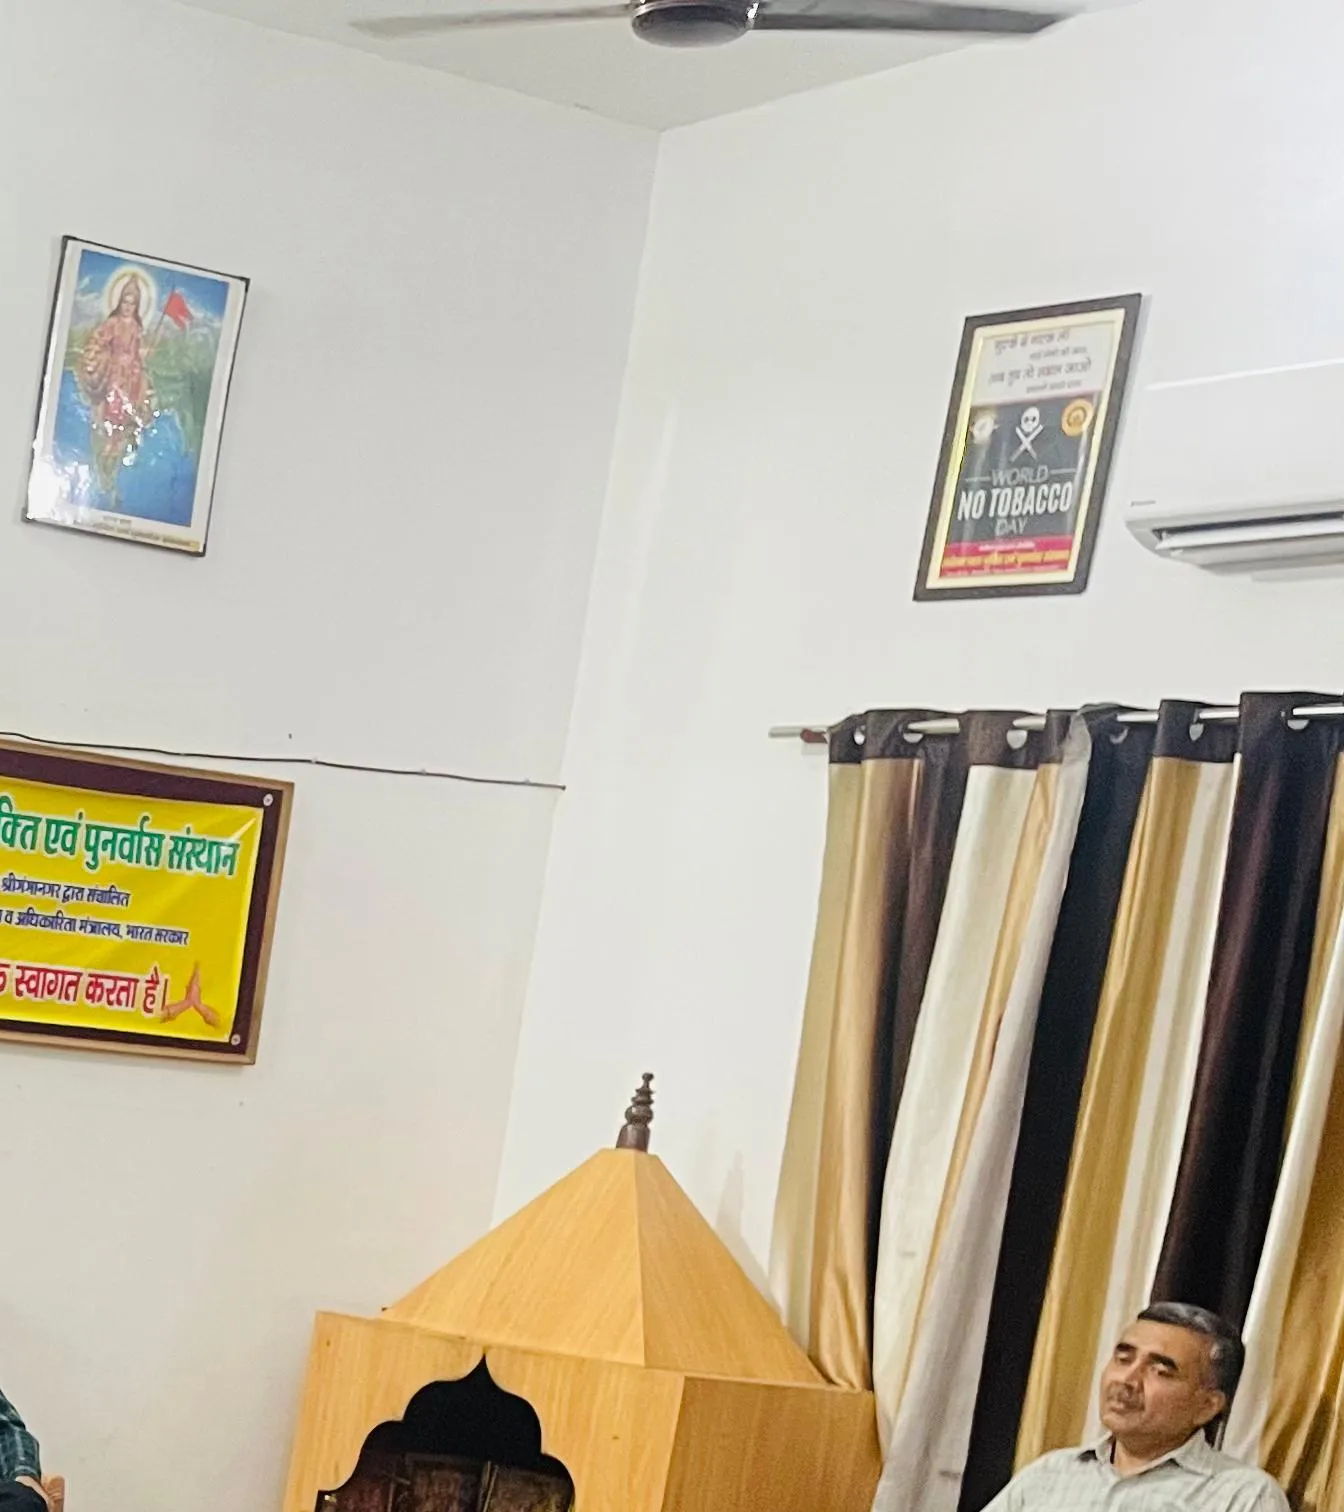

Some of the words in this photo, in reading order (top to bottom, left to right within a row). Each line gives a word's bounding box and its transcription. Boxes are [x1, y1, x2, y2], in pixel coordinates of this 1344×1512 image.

[991, 465, 1049, 486] WORLD
[957, 489, 985, 521] NO
[988, 481, 1073, 518] TOBACCO
[994, 517, 1028, 537] DAY
[44, 811, 81, 856] एवं
[85, 815, 164, 869] पुनर्वास
[168, 826, 240, 876] संस्थान
[1, 872, 62, 899] श्रीगंगानगर
[62, 885, 84, 904] द्वारा
[86, 884, 131, 907] संचालित
[4, 910, 13, 924] व
[15, 907, 76, 932] अधिकारिता
[126, 925, 153, 941] भारत
[154, 929, 189, 945] सरकार
[15, 964, 83, 1002] स्वागत
[85, 972, 140, 1008] करता
